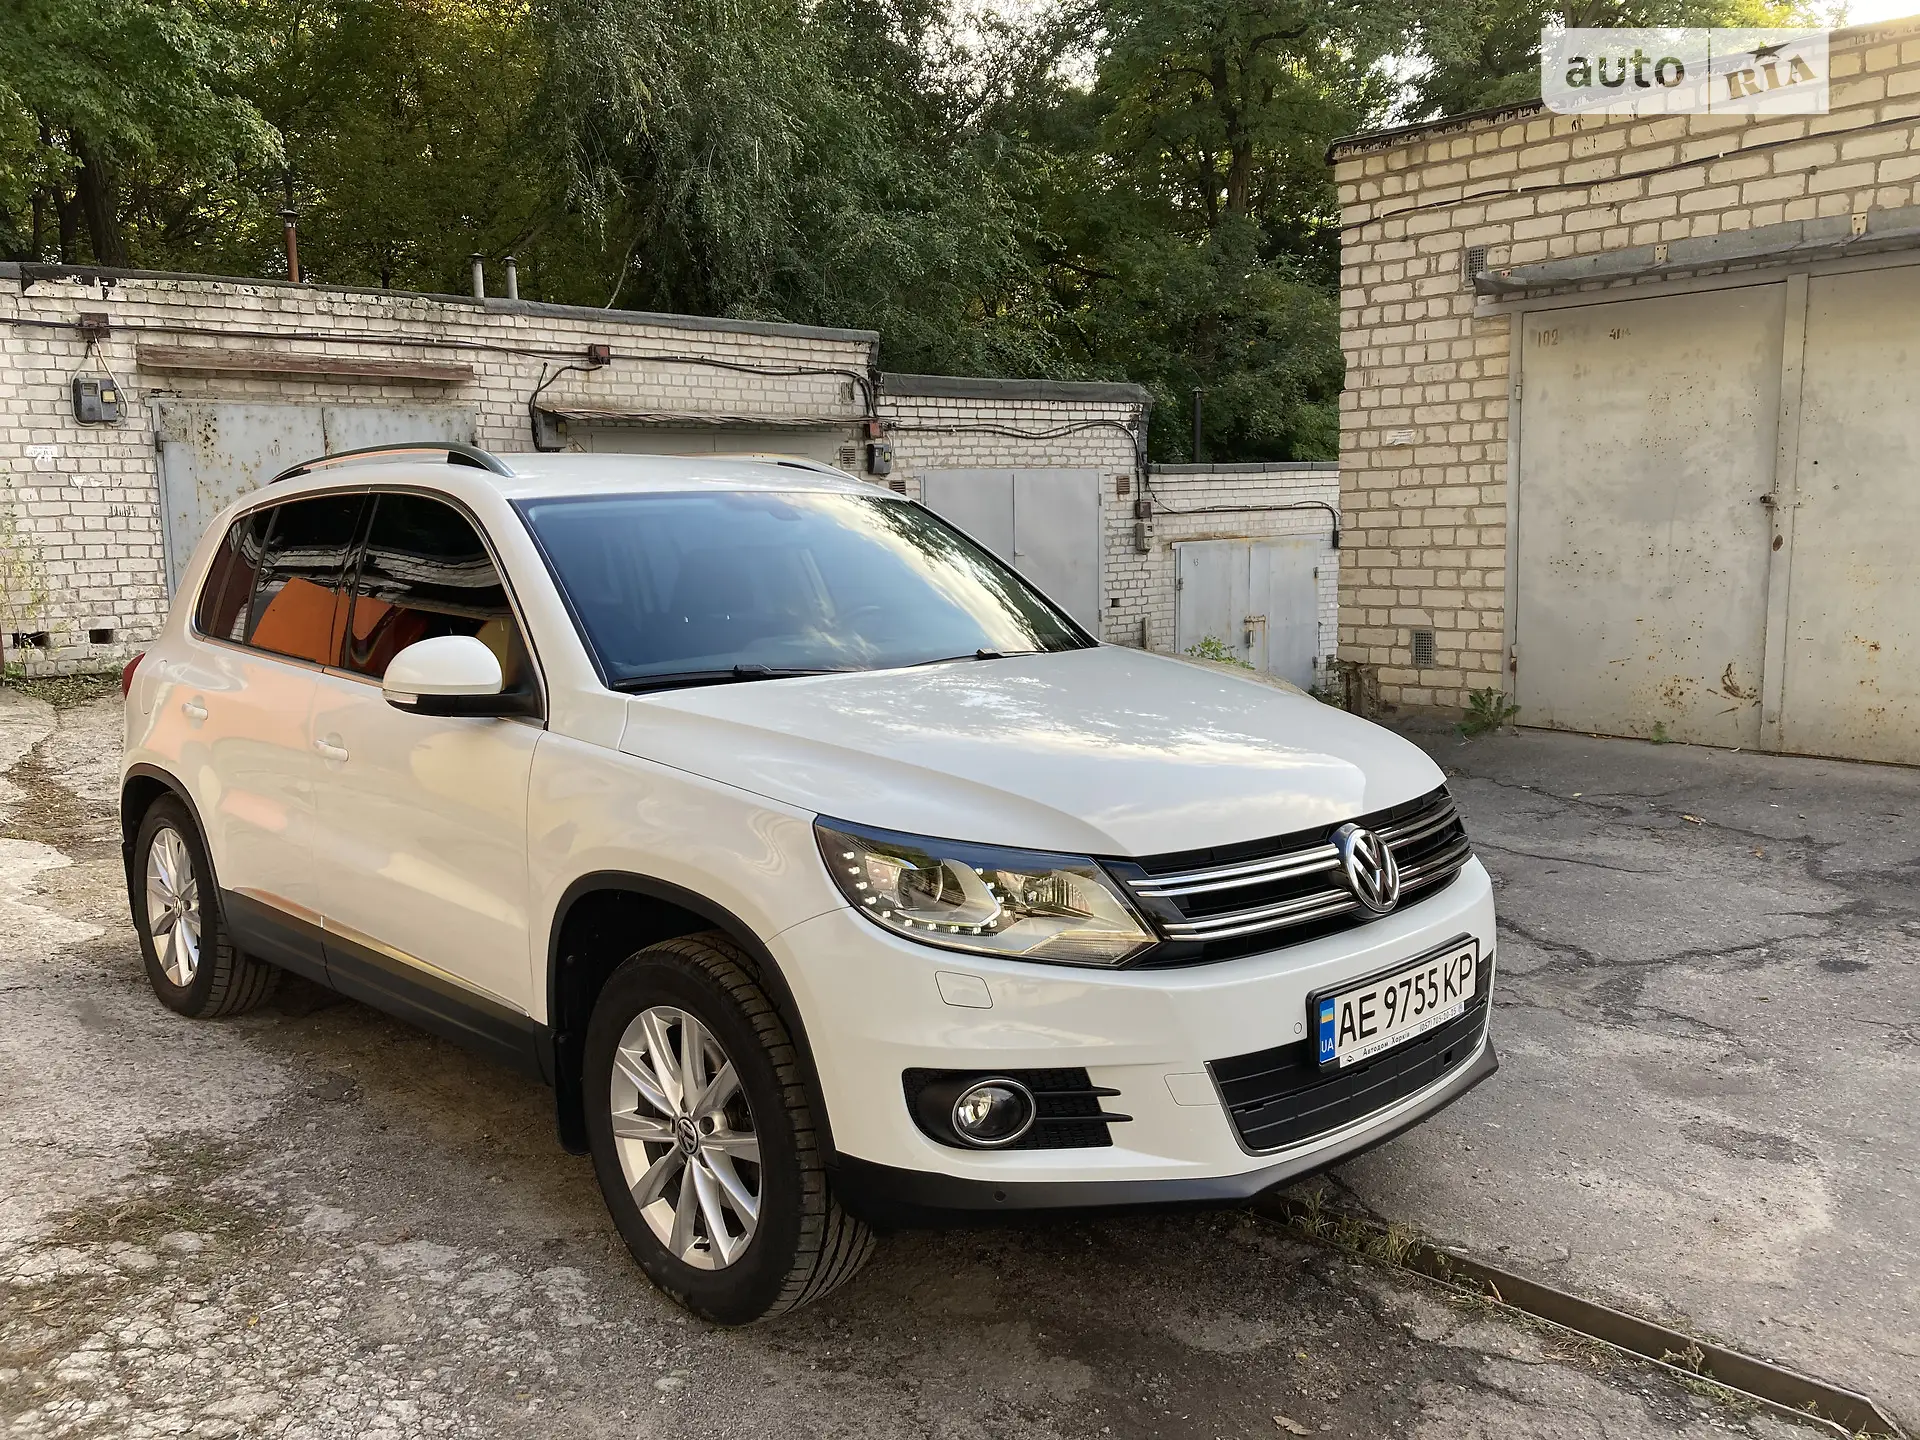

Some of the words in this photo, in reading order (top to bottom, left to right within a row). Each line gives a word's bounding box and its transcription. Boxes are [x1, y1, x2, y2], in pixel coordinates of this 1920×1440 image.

[1337, 991, 1378, 1048] AE
[1383, 967, 1439, 1029] 9755
[1444, 952, 1473, 1003] KP
[1321, 1037, 1335, 1054] UA
[1362, 1041, 1389, 1057] Автодом
